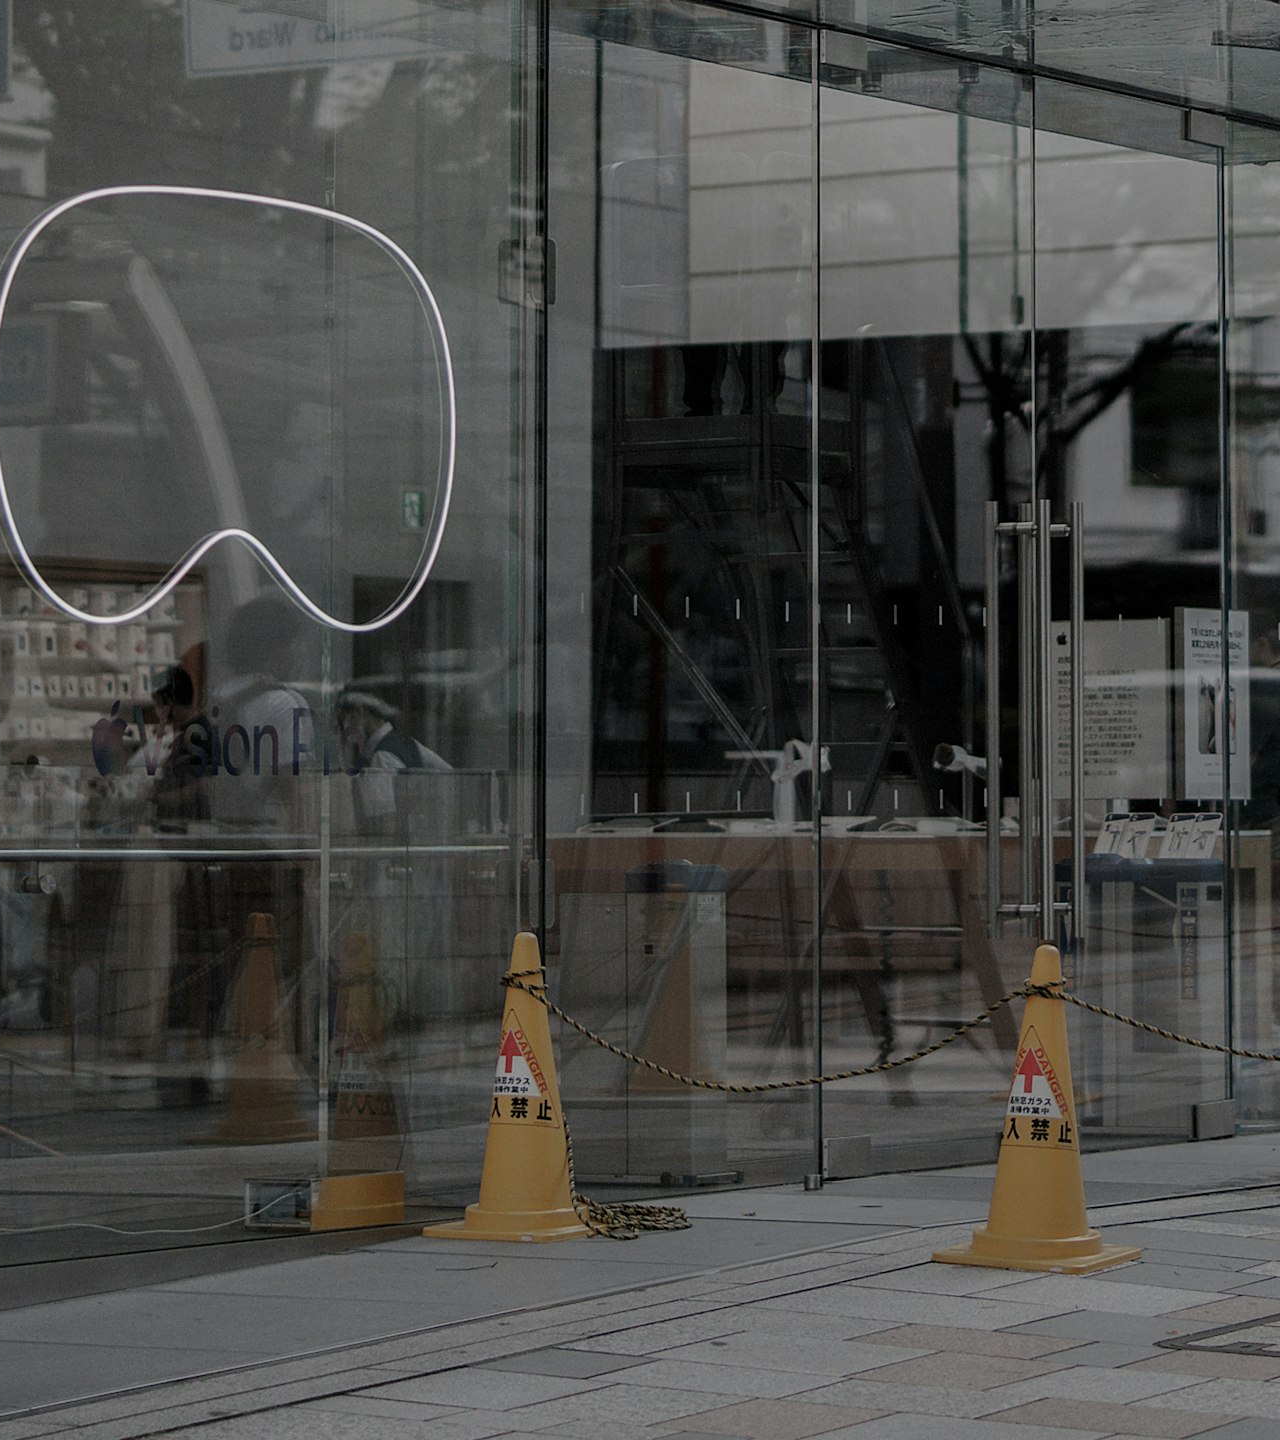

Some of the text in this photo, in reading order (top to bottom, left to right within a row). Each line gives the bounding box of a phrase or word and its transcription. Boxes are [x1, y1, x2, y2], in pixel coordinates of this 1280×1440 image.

[514, 1029, 547, 1092] DANGER
[1035, 1048, 1068, 1114] DANGER
[1000, 1118, 1072, 1143] 入禁止
